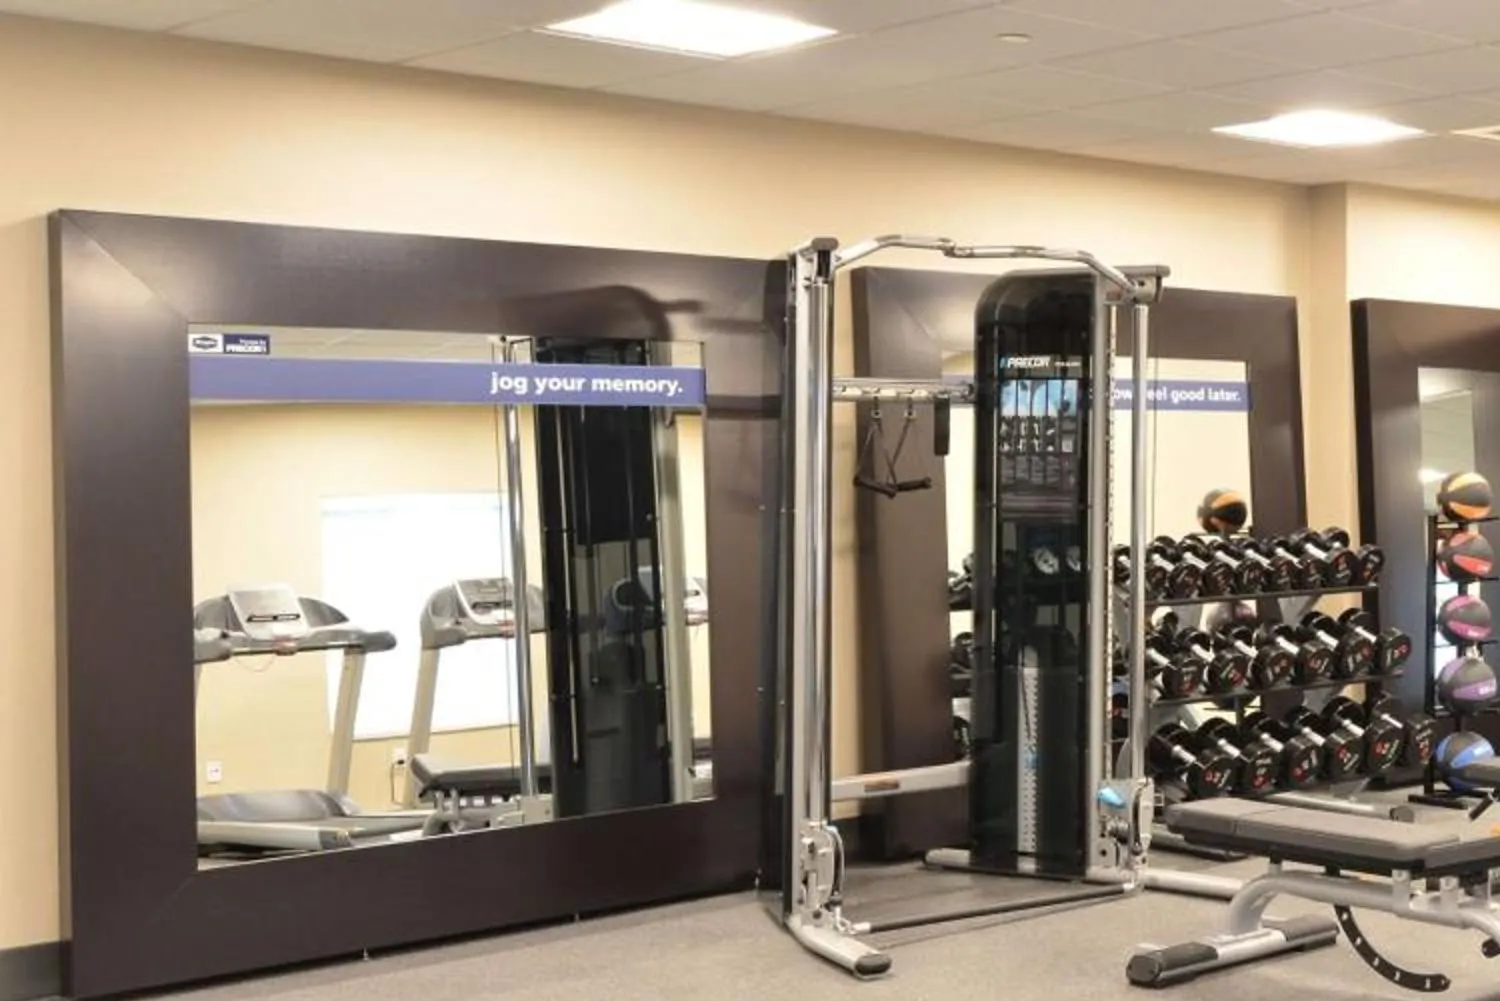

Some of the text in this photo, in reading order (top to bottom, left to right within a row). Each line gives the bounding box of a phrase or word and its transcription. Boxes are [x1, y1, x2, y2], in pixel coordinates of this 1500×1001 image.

[490, 371, 683, 397] jog your memory.
[1171, 387, 1205, 404] good
[1208, 387, 1241, 401] later.
